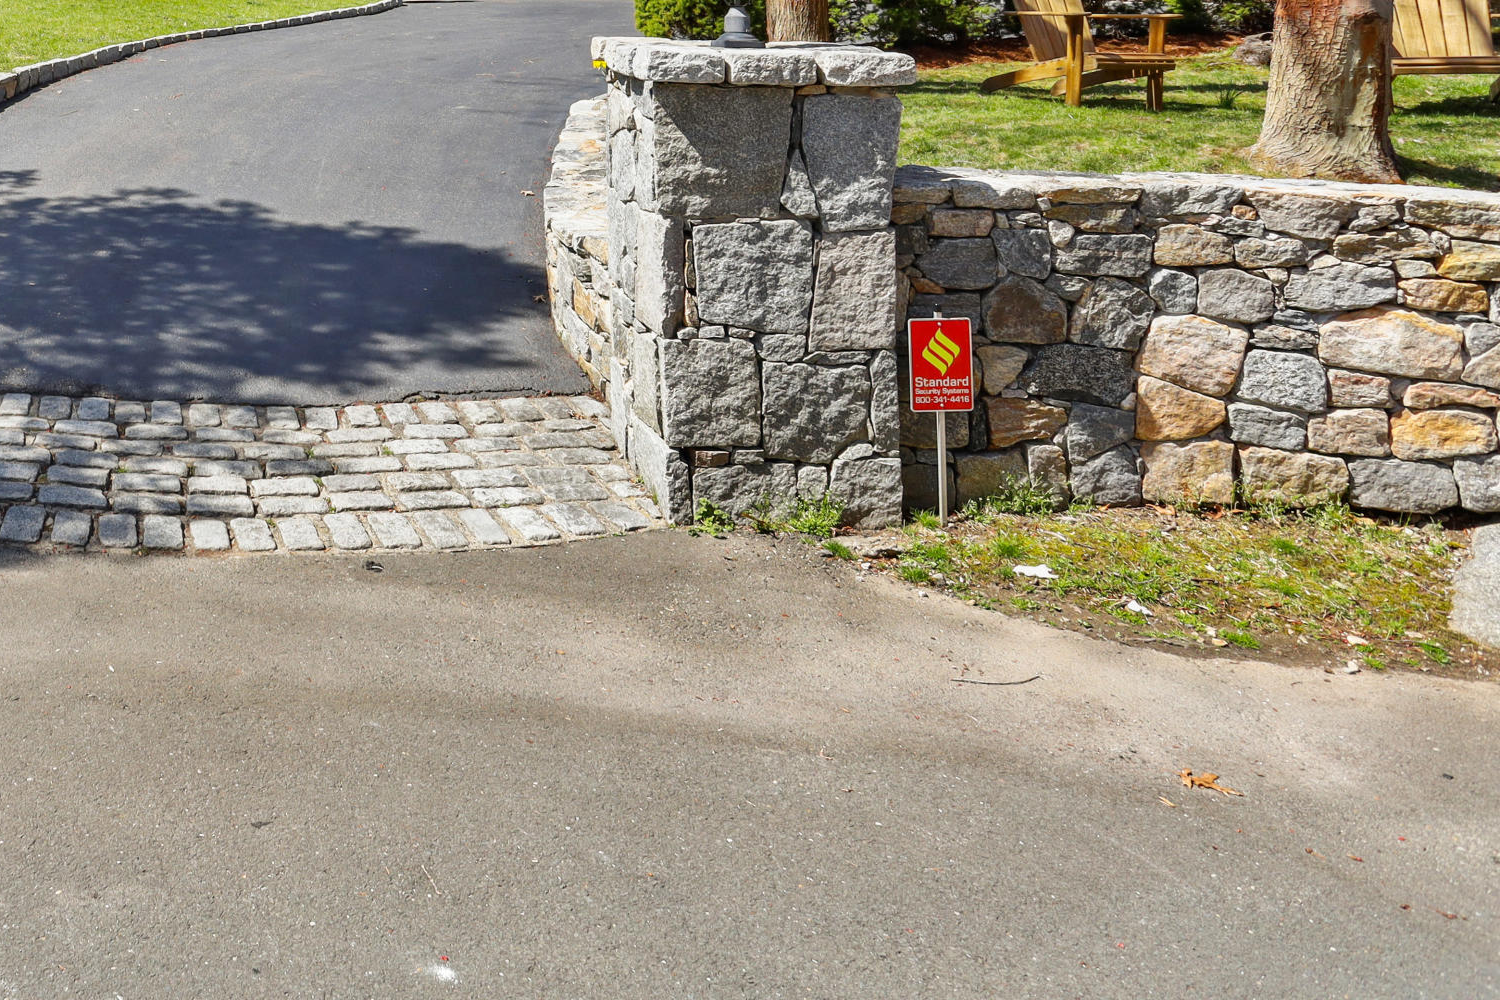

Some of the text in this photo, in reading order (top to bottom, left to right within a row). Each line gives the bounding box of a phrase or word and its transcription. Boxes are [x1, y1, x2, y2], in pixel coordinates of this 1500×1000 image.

[915, 376, 969, 387] Standard
[915, 387, 969, 396] Security Systems
